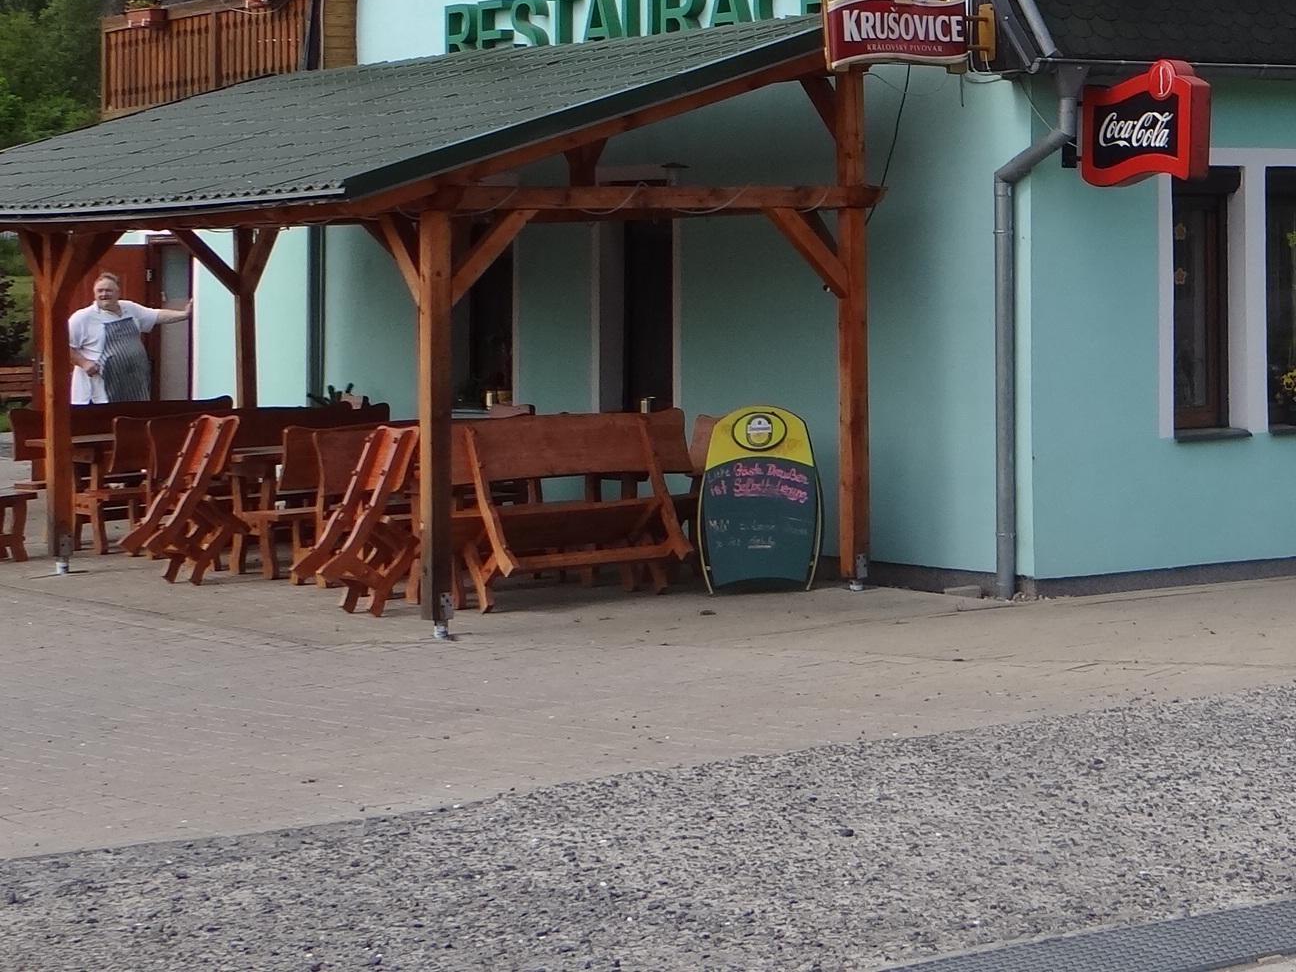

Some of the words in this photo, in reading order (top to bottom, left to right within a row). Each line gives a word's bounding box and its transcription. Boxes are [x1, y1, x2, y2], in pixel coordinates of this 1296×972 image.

[842, 7, 965, 42] KRUŠOVICE
[909, 43, 944, 53] PIVOVAR
[1099, 111, 1174, 148] Coca-Cola
